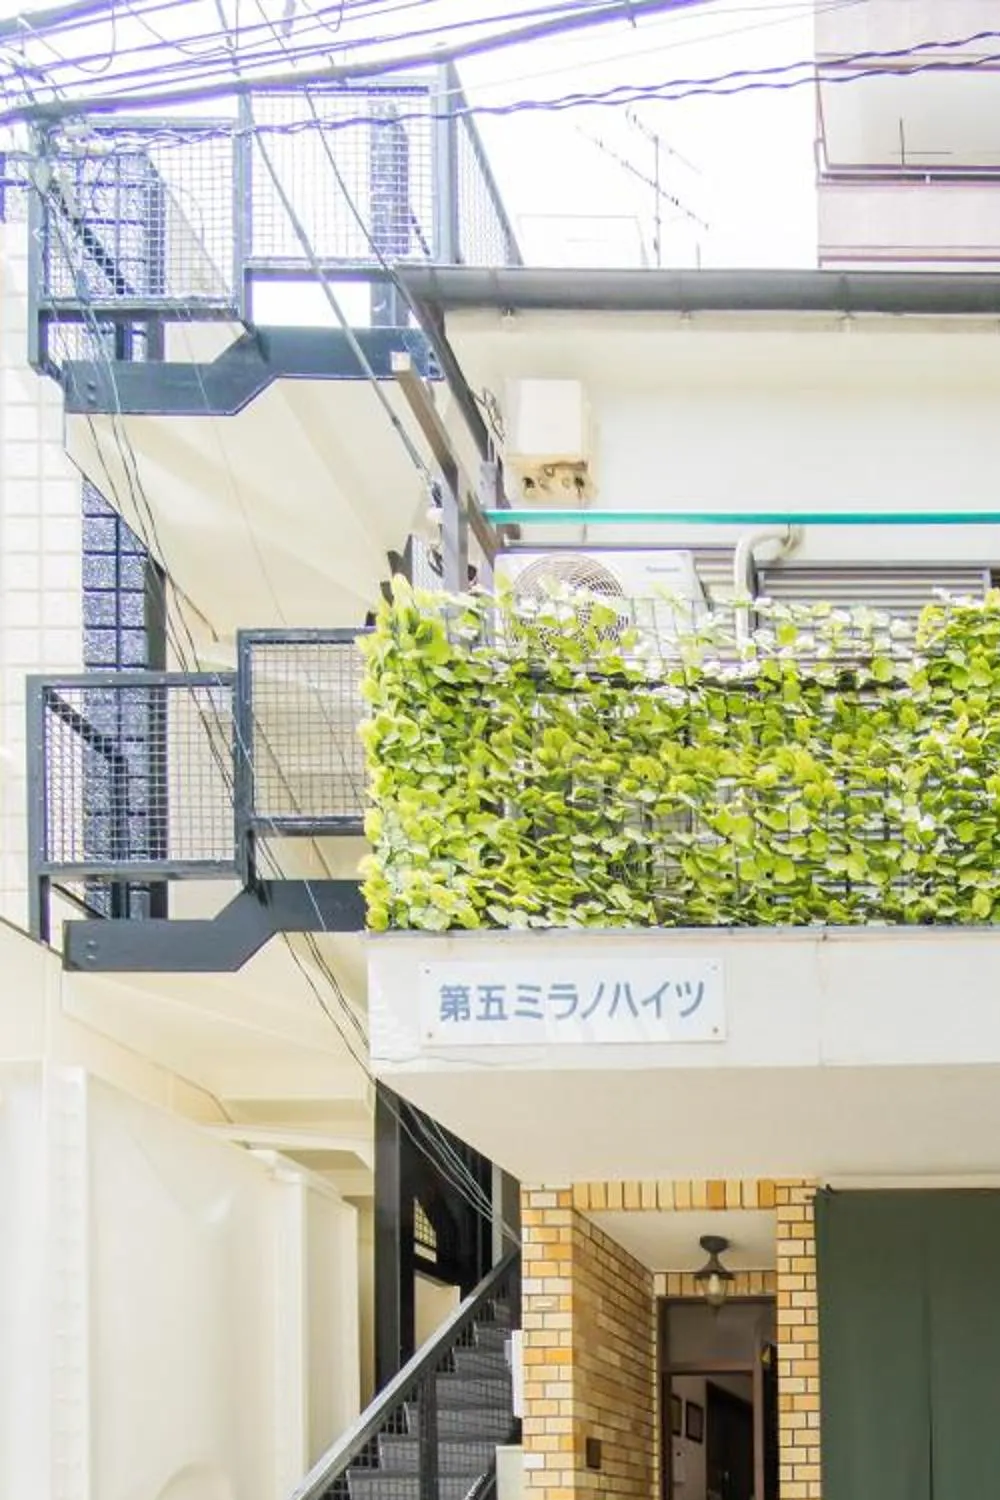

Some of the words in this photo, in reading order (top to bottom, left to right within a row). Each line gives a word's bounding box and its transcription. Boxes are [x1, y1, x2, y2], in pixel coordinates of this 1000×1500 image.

[438, 980, 705, 1023] 第五ミラノハイツ
